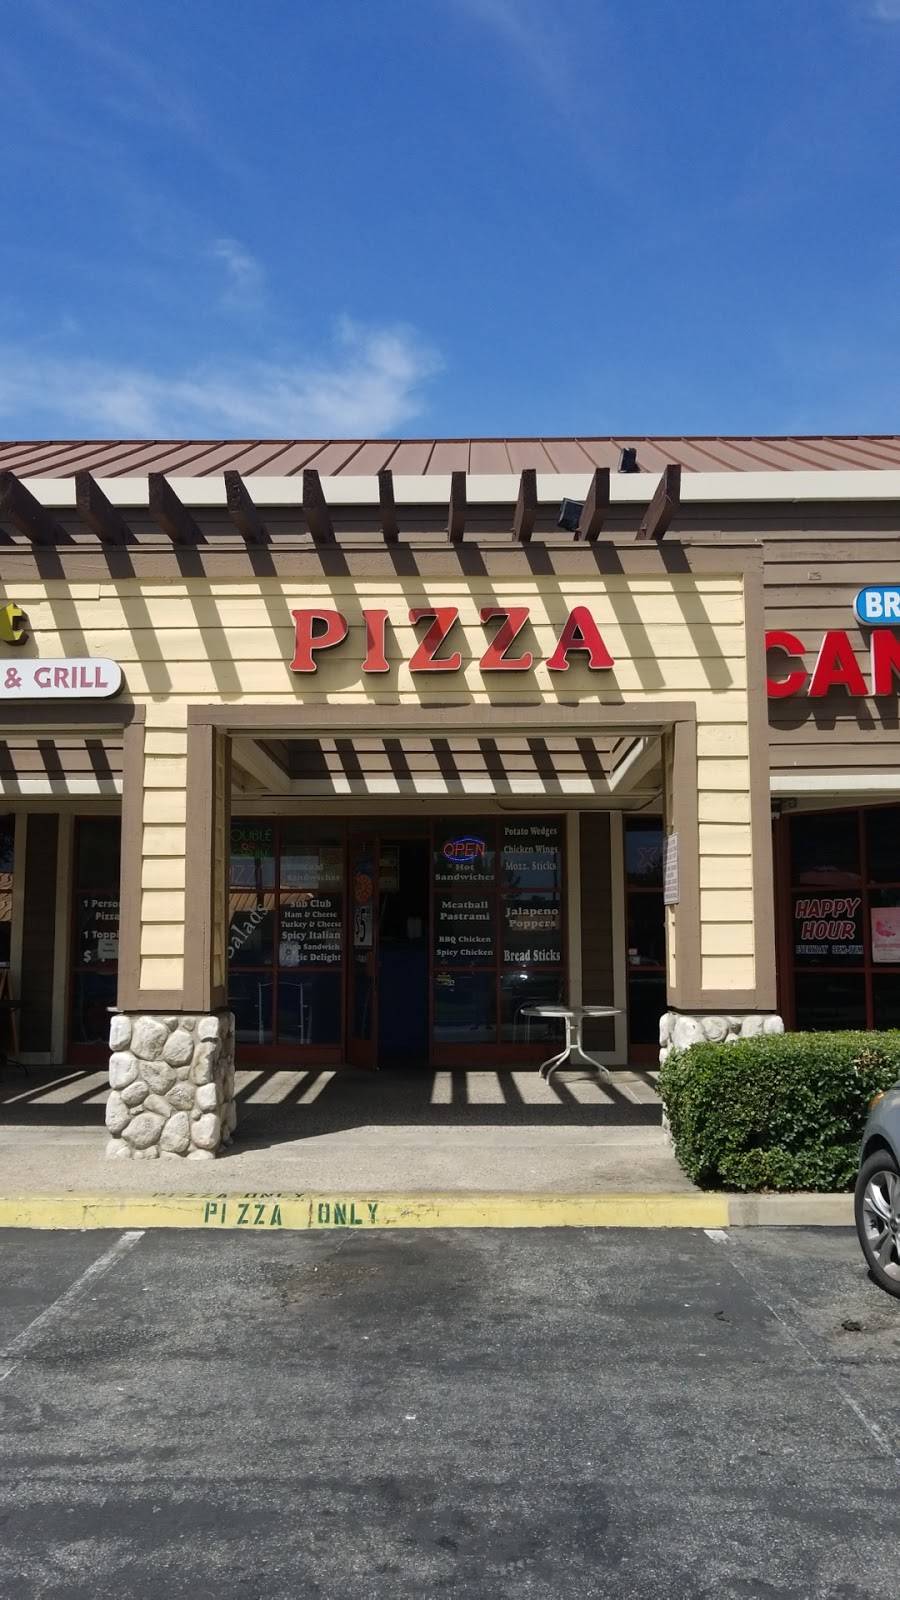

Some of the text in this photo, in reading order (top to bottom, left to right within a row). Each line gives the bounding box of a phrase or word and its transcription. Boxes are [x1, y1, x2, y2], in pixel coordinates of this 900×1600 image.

[289, 606, 615, 672] PIZZA
[4, 667, 109, 689] & GRILL
[504, 827, 557, 837] Potato Wedges
[443, 842, 485, 857] OPEN
[504, 845, 558, 856] Chicken Wings
[532, 861, 557, 871] Sticks
[435, 873, 495, 881] Sandwiches
[83, 900, 120, 908] 1 Perso
[290, 899, 331, 908] Sub Club
[441, 900, 488, 909] Meatball
[795, 898, 861, 919] HAPPY
[440, 912, 490, 920] Pastrami
[505, 907, 559, 917] Jalapeno
[281, 921, 307, 929] Turkey
[509, 920, 556, 930] Poppers
[801, 920, 856, 940] HOUR
[83, 930, 89, 939] 1
[281, 931, 341, 941] Spicy Italian
[439, 936, 456, 944] BBQ
[303, 943, 340, 951] Sandwich
[310, 954, 341, 963] Delight
[436, 949, 458, 958] Spicy
[504, 949, 560, 961] Bread Sticks
[204, 1202, 379, 1226] PIZZA ONLY
